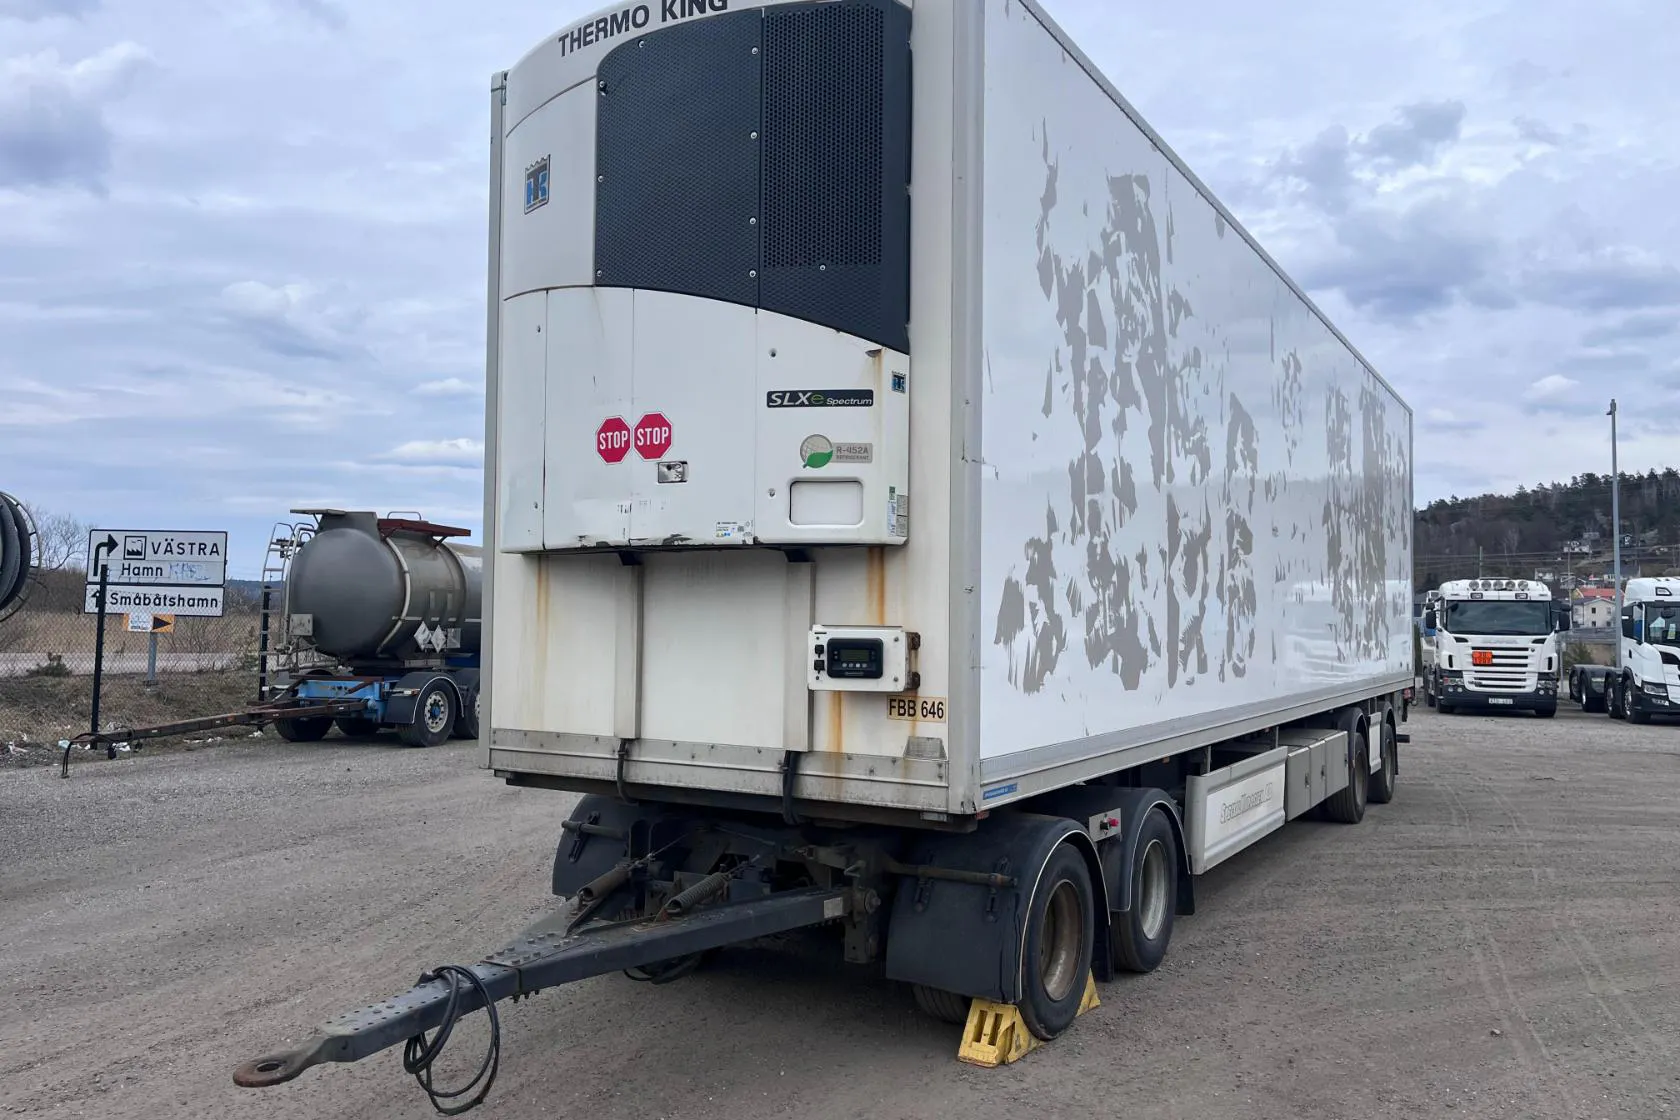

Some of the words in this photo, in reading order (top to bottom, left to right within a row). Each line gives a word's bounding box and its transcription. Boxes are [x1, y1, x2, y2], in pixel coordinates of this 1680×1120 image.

[558, 4, 650, 57] THERMO
[661, 0, 728, 23] KING
[826, 397, 872, 406] Spectrum
[600, 430, 628, 449] STOP
[637, 427, 669, 446] STOP
[836, 446, 869, 455] R-452A
[151, 538, 220, 556] VÄSTRA
[122, 563, 163, 577] Hamn
[110, 592, 218, 608] Småbåtshamn
[889, 699, 917, 717] FBB
[921, 700, 944, 719] 646
